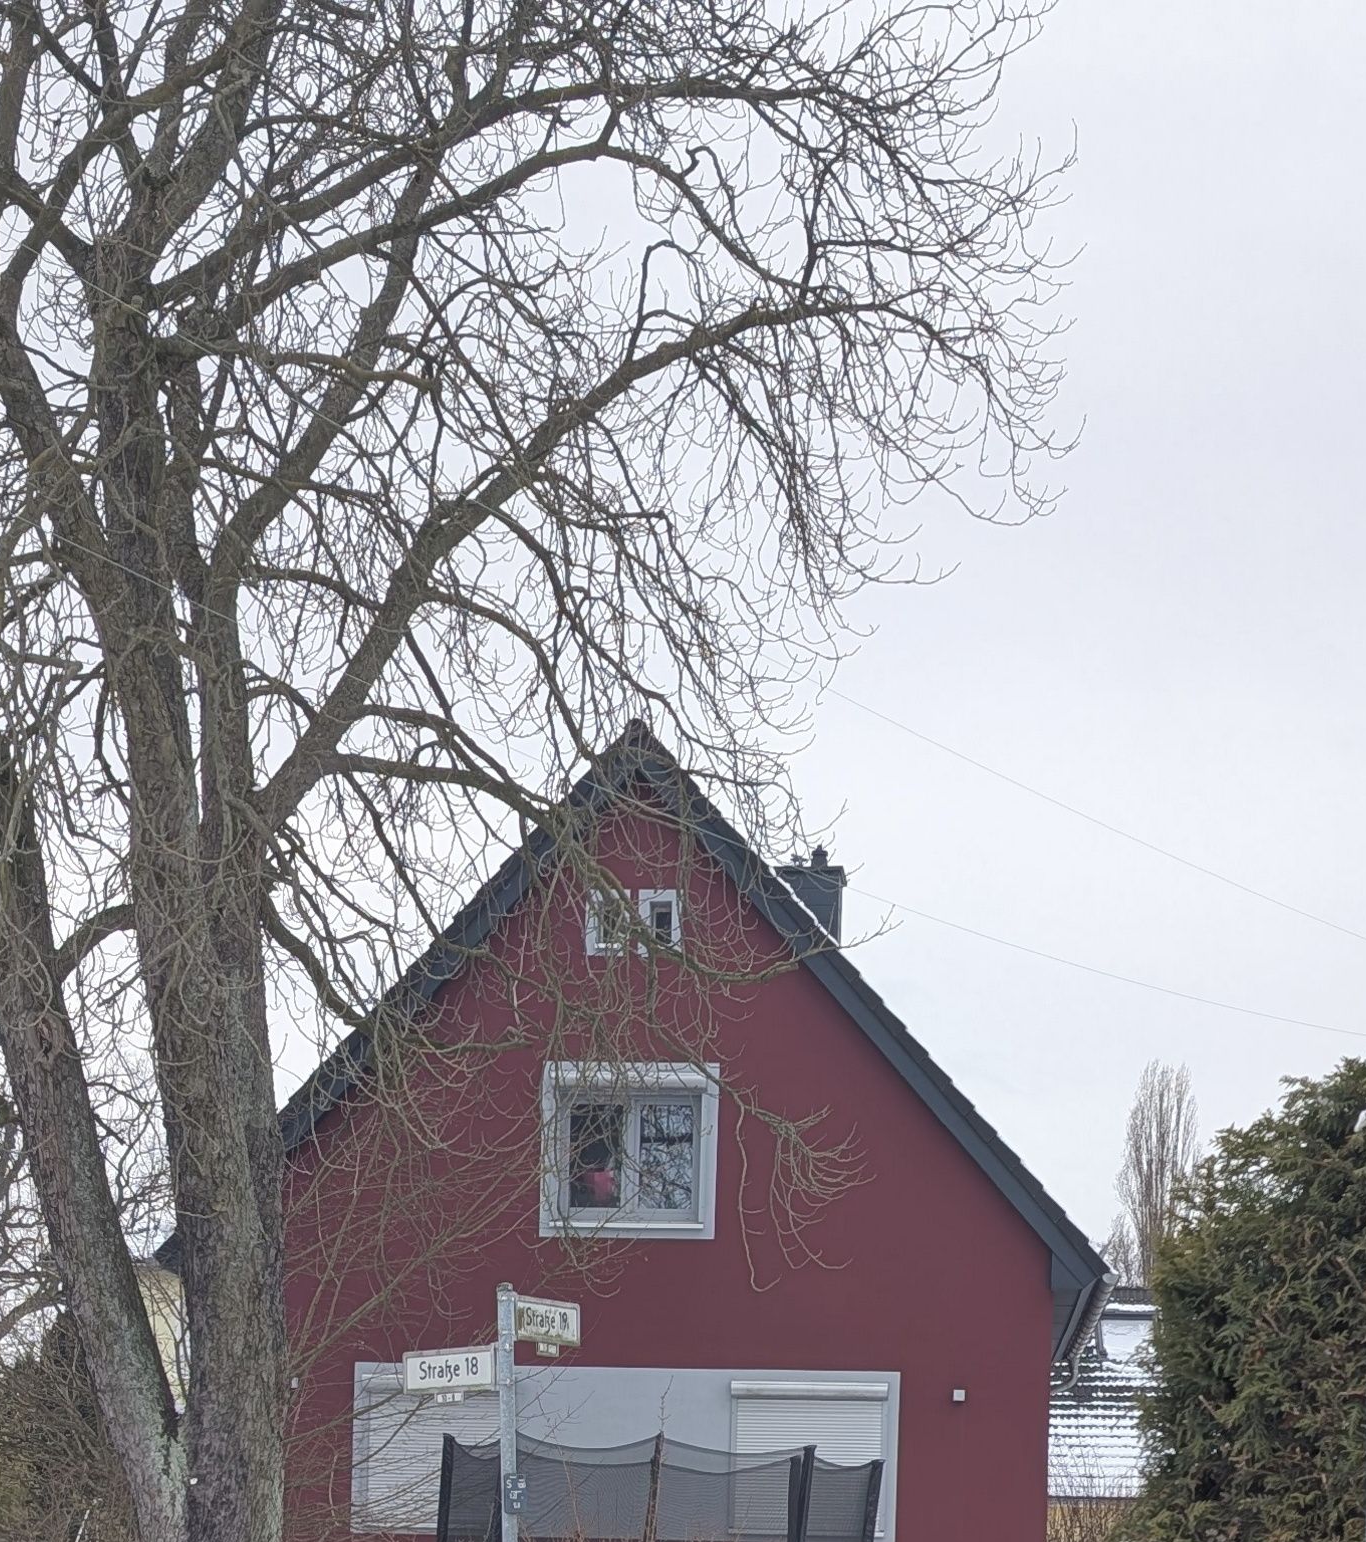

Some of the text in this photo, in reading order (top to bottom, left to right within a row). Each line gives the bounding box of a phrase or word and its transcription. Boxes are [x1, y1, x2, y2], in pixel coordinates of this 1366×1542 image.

[525, 1307, 555, 1334] Straße
[419, 1356, 479, 1383] Straße 18
